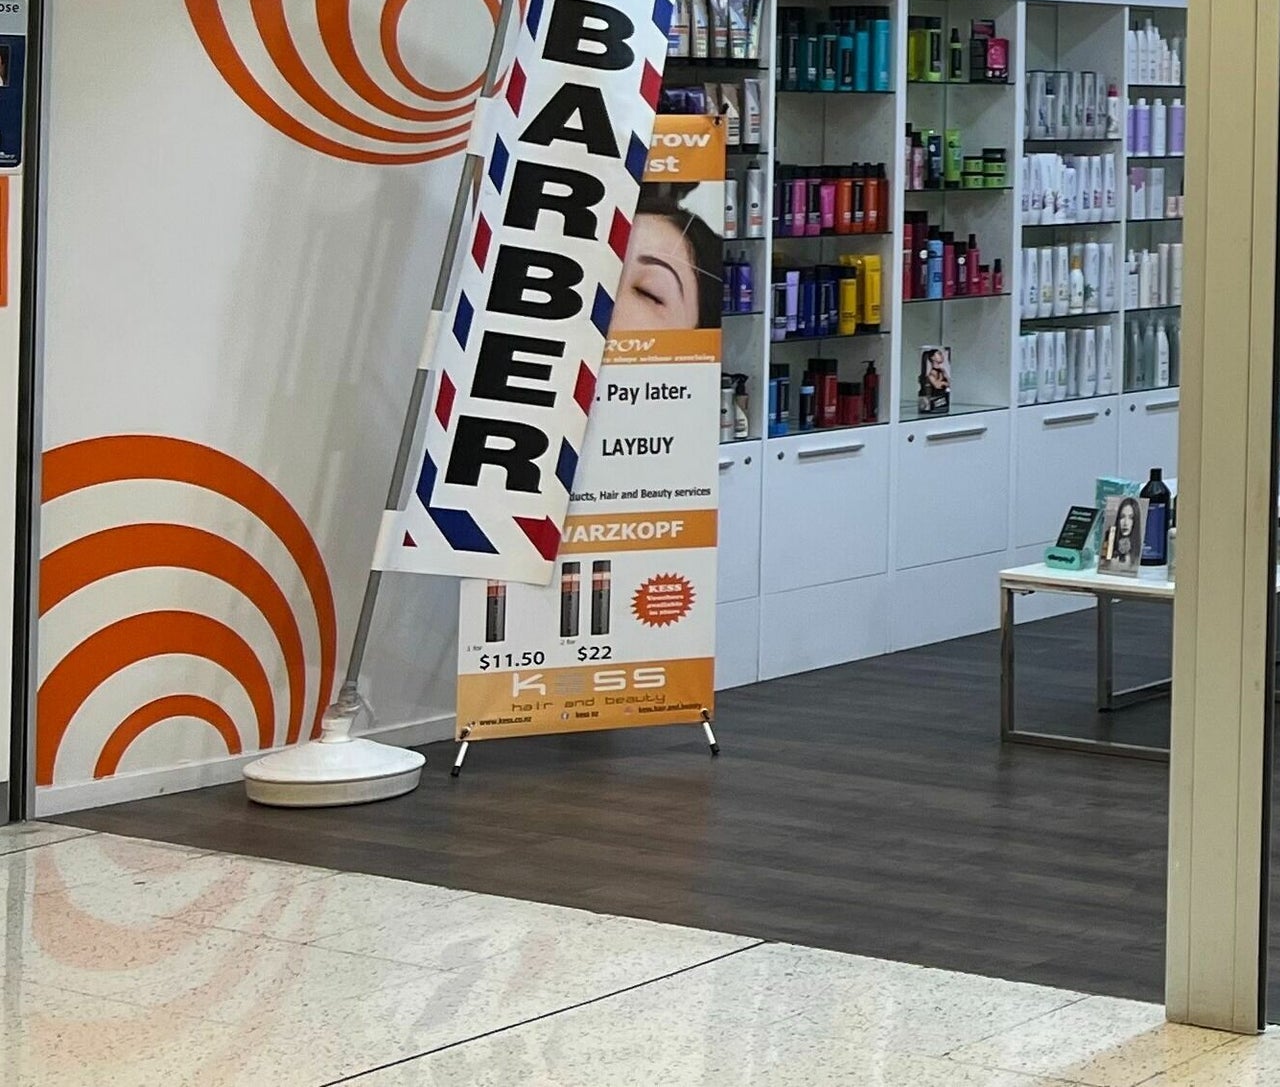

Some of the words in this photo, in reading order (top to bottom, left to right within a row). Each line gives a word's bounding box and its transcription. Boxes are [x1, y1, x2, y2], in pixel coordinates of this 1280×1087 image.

[607, 382, 640, 405] Pay
[645, 381, 692, 401] later.
[602, 436, 674, 457] LAYBUY
[599, 489, 619, 501] Hair
[620, 488, 638, 500] and
[641, 488, 672, 500] Beauty
[674, 486, 711, 498] services
[479, 651, 545, 671] $11.50
[577, 645, 613, 662] $22
[511, 701, 554, 712] hair
[564, 696, 596, 708] and
[604, 693, 667, 706] beauty
